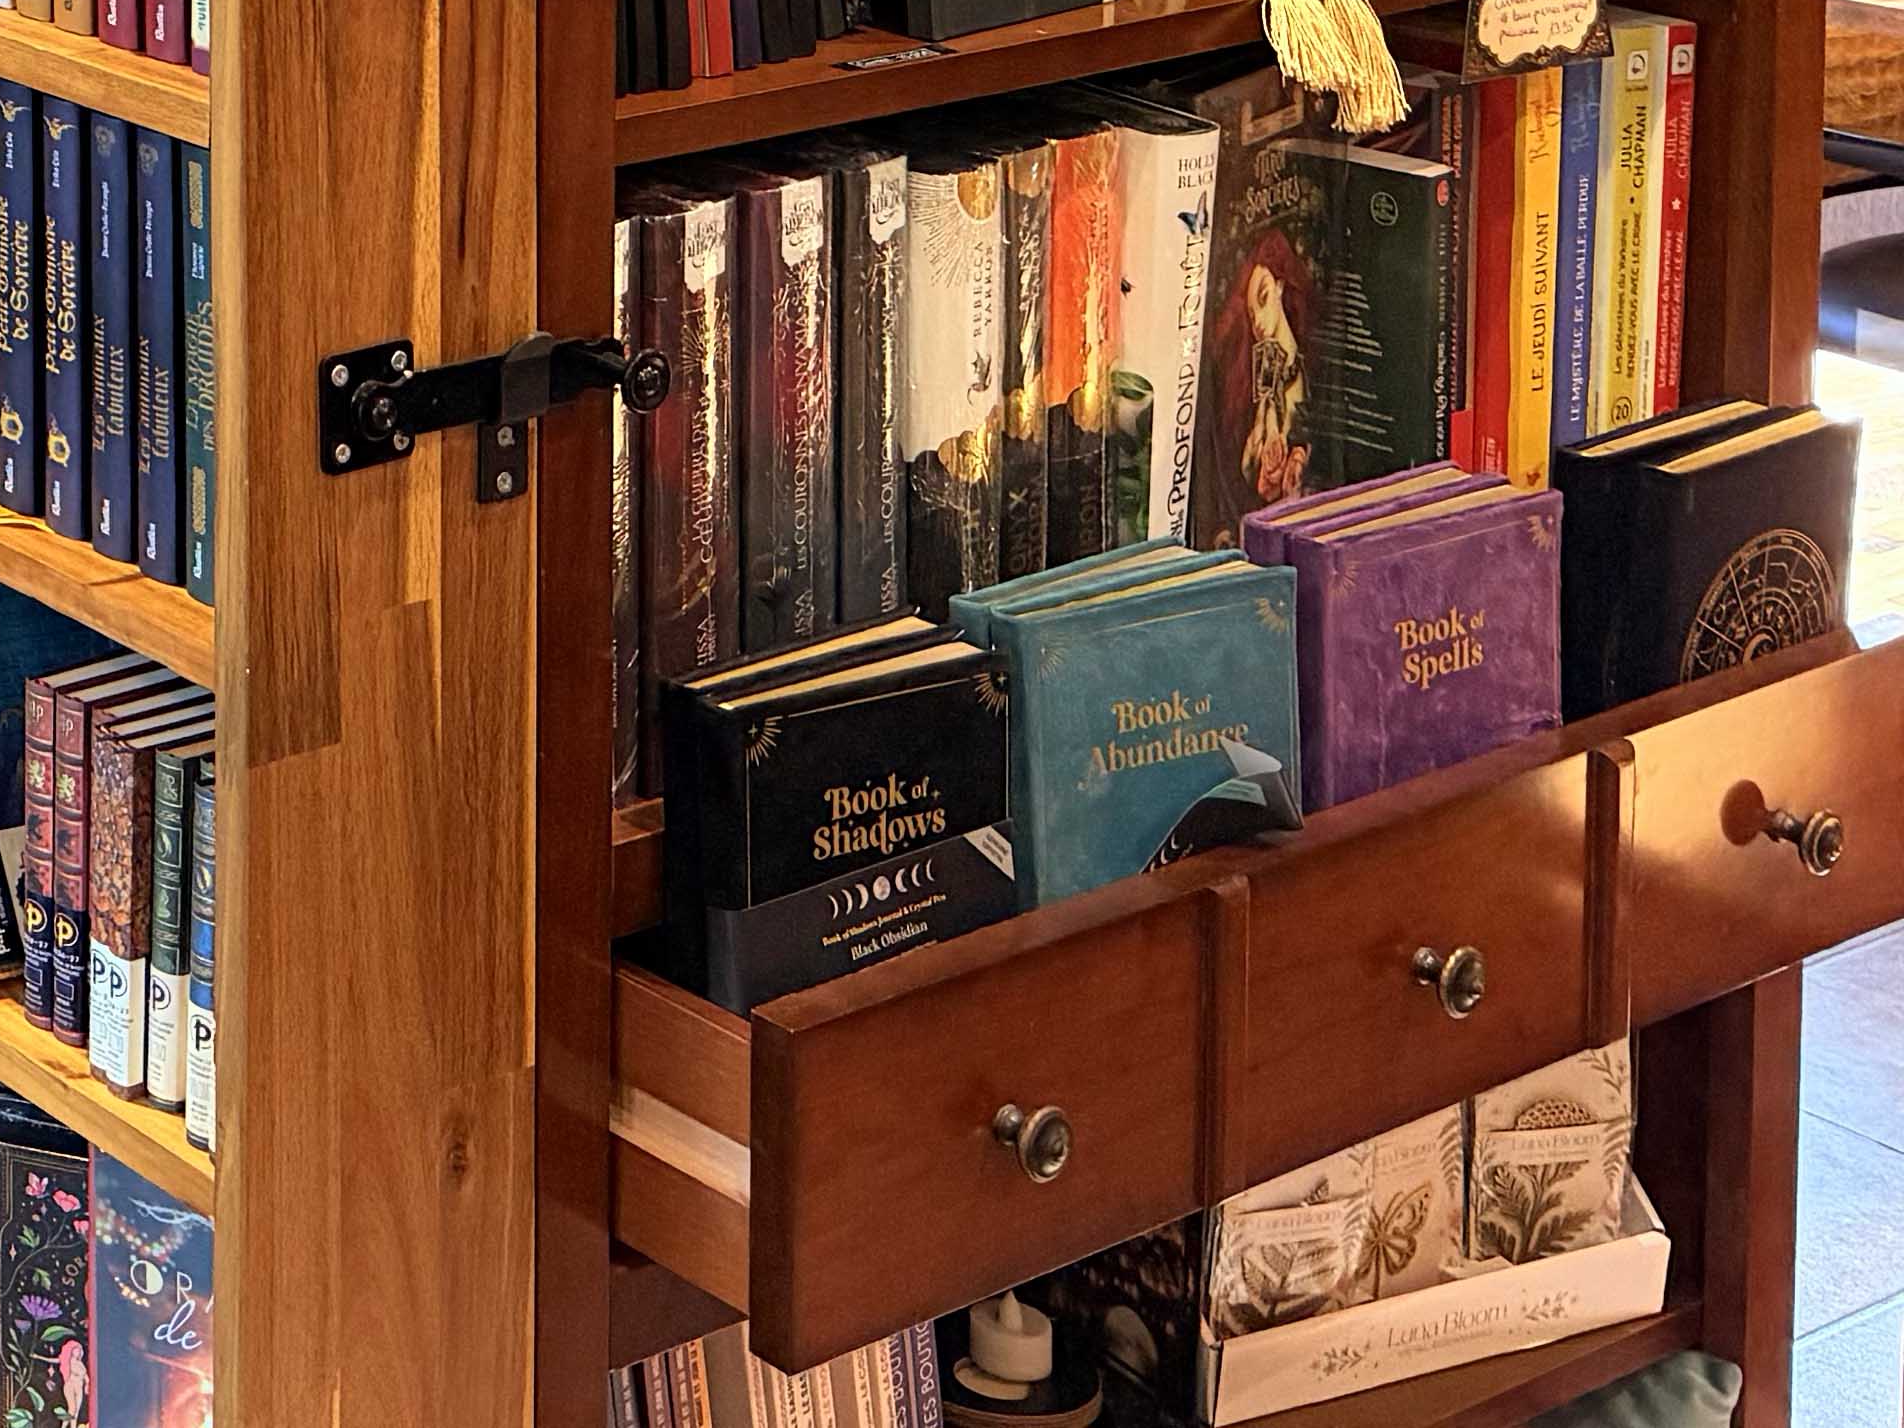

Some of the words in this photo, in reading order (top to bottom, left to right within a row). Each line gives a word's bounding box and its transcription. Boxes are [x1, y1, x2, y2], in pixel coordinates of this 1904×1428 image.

[1620, 124, 1633, 170] JULIA
[1633, 105, 1647, 188] CHAPMAN
[1664, 118, 1678, 161] JULIA
[1677, 100, 1692, 178] CHAPMAN
[1177, 172, 1215, 190] BLACK
[1532, 211, 1550, 295] SUIVANT
[972, 241, 984, 337] REBECCA
[1532, 305, 1546, 360] JEUDI
[106, 345, 125, 437] fabuleux
[1531, 368, 1544, 392] LE
[152, 366, 170, 459] fabuleux
[1167, 363, 1193, 515] PROFOND
[1394, 606, 1466, 650] Book
[1470, 611, 1485, 630] of
[1401, 637, 1484, 690] Spells
[1111, 690, 1190, 734] Book
[1194, 694, 1211, 715] of
[1092, 721, 1248, 776] Abundance
[824, 773, 907, 821] Book
[912, 776, 930, 800] of
[813, 808, 946, 860] Shadows
[850, 939, 880, 960] Black
[881, 921, 928, 948] Obsidian
[1444, 1306, 1508, 1336] Bloom
